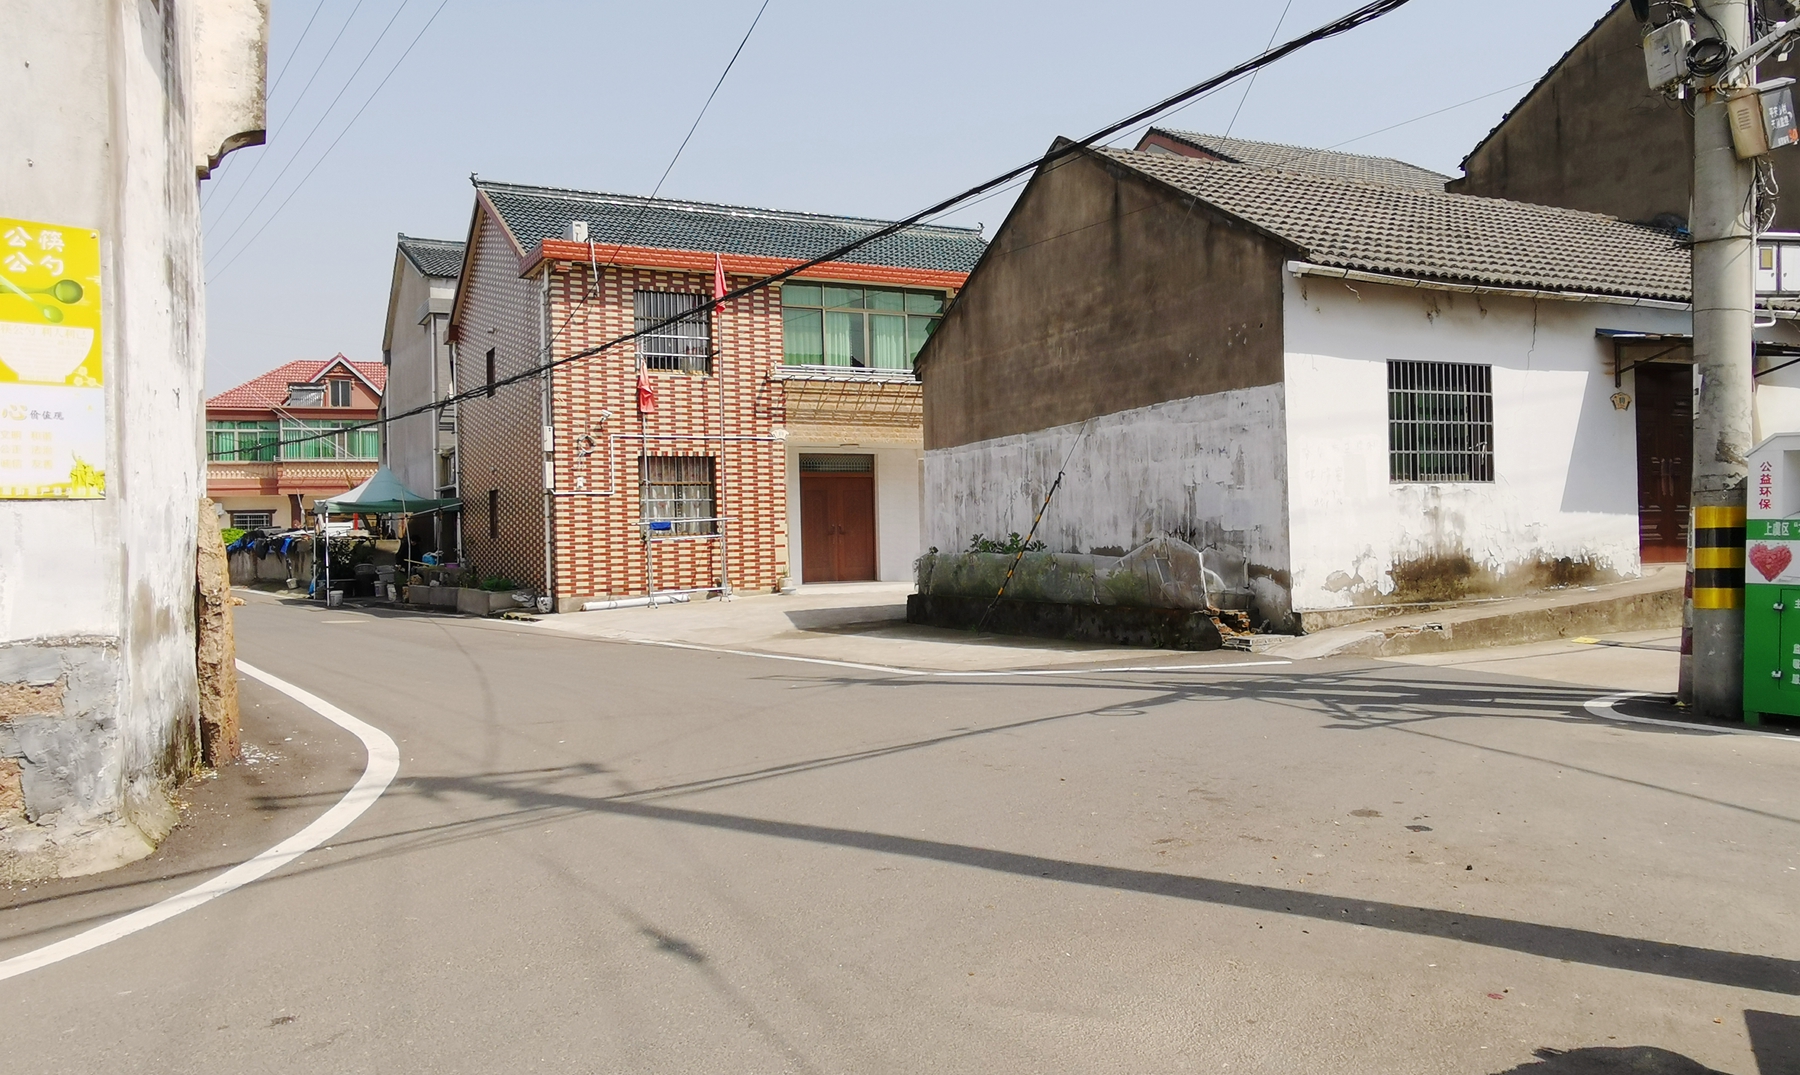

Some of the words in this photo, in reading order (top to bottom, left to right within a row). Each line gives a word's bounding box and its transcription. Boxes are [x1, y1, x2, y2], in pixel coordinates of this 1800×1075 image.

[4, 226, 65, 252] 公筷
[4, 252, 65, 277] 公勺
[1759, 461, 1773, 510] 公益环保
